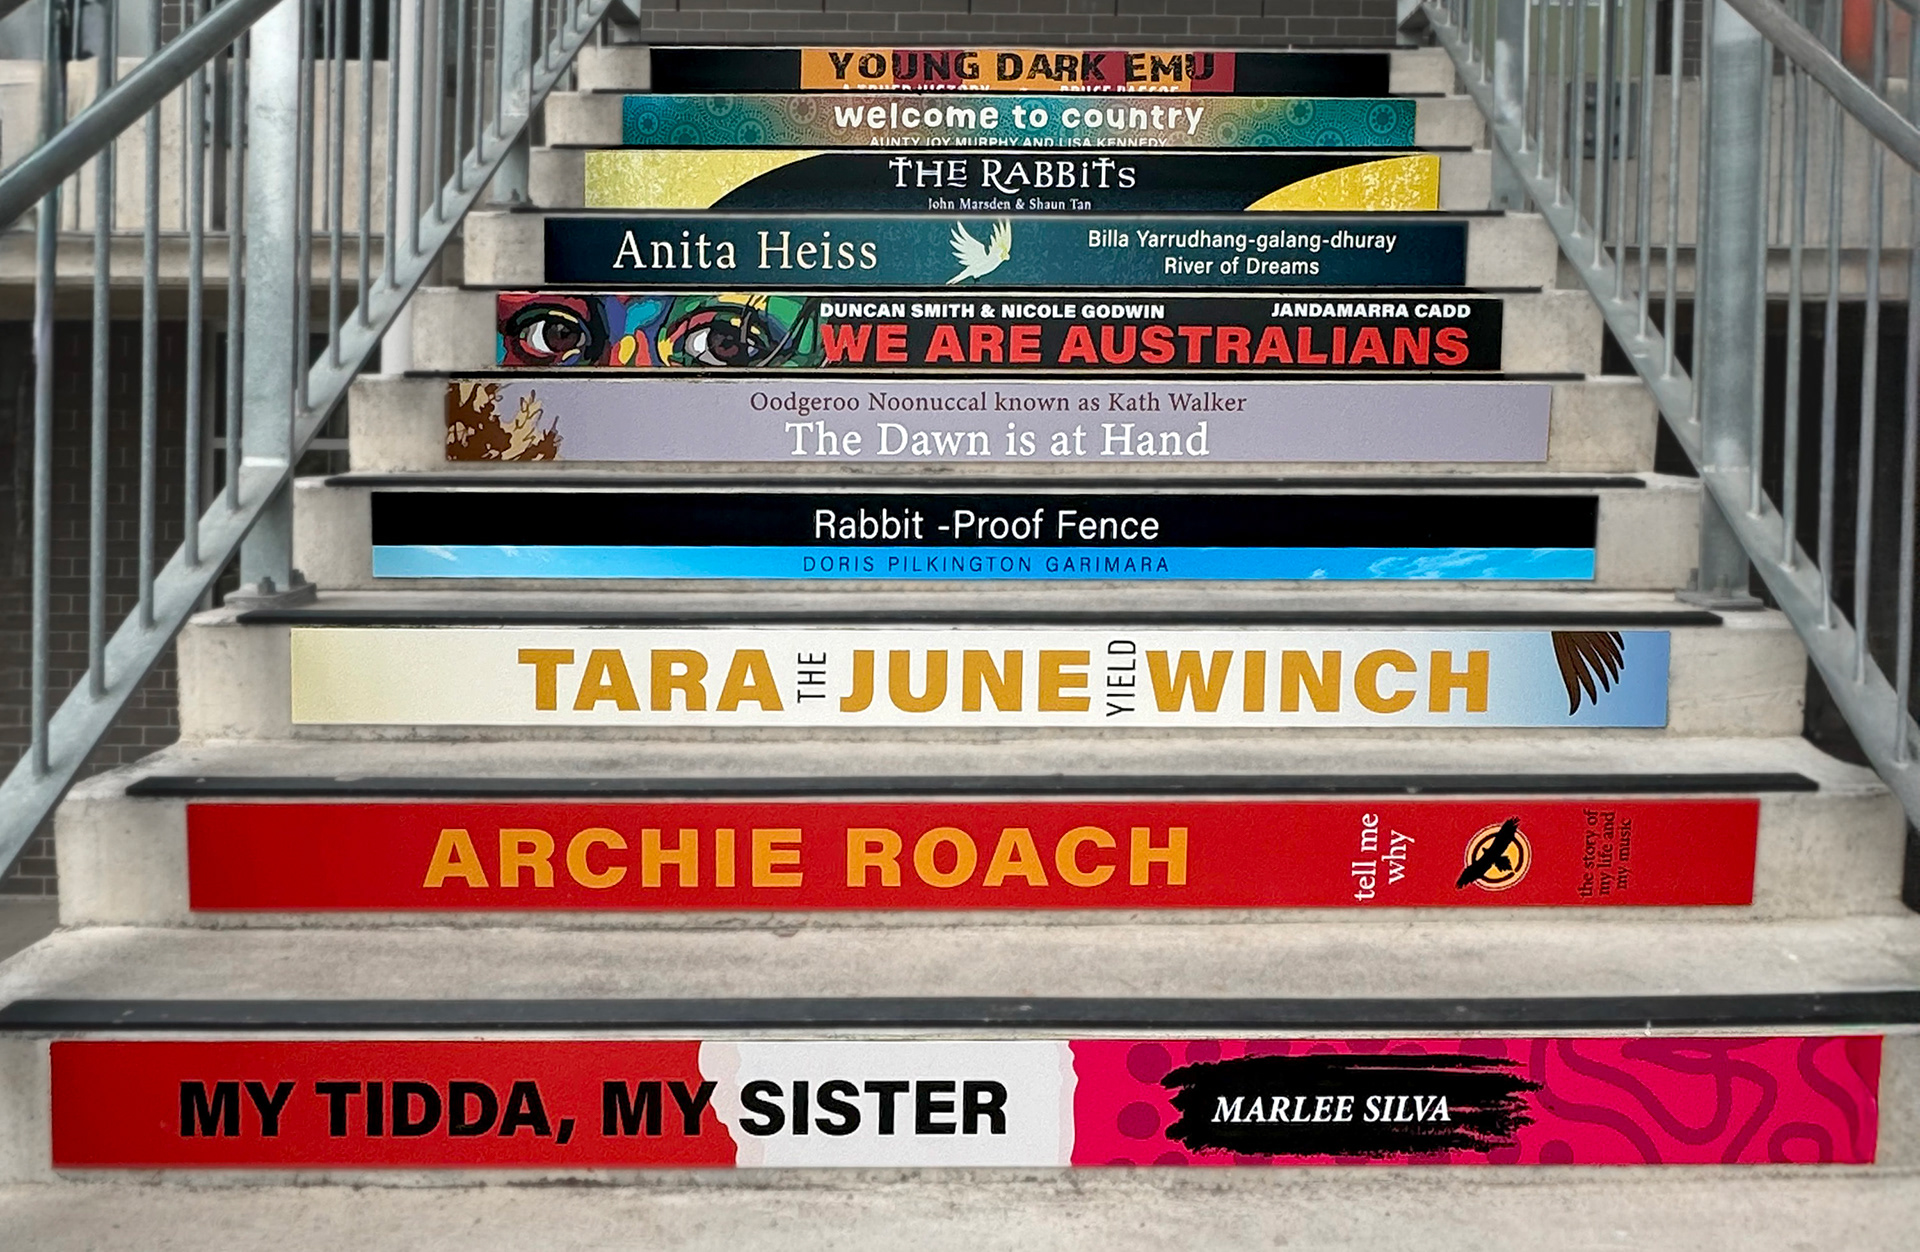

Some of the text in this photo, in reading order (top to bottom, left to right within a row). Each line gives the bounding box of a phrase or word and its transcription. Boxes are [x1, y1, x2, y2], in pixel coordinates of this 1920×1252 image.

[829, 51, 1214, 82] YOUNG DARK EMU
[834, 102, 1205, 136] welcome to country
[869, 136, 1168, 147] AUNTY JOY MURPHY AND LISA KENNEDY
[889, 156, 968, 188] THE
[928, 196, 1092, 211] John Marsden & Shaun Tan
[612, 230, 877, 270] Anita Heiss
[1088, 229, 1397, 254] Billa Yarrudhang-galang-dhuray
[1164, 256, 1320, 275] River of Dreams
[820, 302, 1165, 319] DUNCAN SMITH & NICOLE GODWIN
[1271, 302, 1471, 318] JANDAMARRA CADD
[822, 324, 1470, 366] WE ARE AUSTRALIANS
[750, 391, 1248, 416] Oodgeroo Noonuccal known as Kath Walker
[784, 420, 1210, 456] The Dawn is at Hand
[815, 507, 1159, 540] Rabbit -Proof Fence
[803, 555, 1169, 573] DORIS PILKINGTON GARIMARA
[518, 648, 1489, 714] TARA JUNE WINCH
[797, 652, 827, 704] THE
[1105, 640, 1136, 717] YIELD
[422, 825, 1189, 889] ARCHIE ROACH
[1352, 813, 1379, 902] tell me
[1381, 829, 1415, 885] why
[1577, 808, 1600, 897] the story of
[1597, 812, 1616, 895] my life and
[1617, 818, 1632, 889] my music
[179, 1079, 1008, 1146] MY TIDDA, MY SISTER
[1210, 1095, 1453, 1124] MARLEE SILVA
